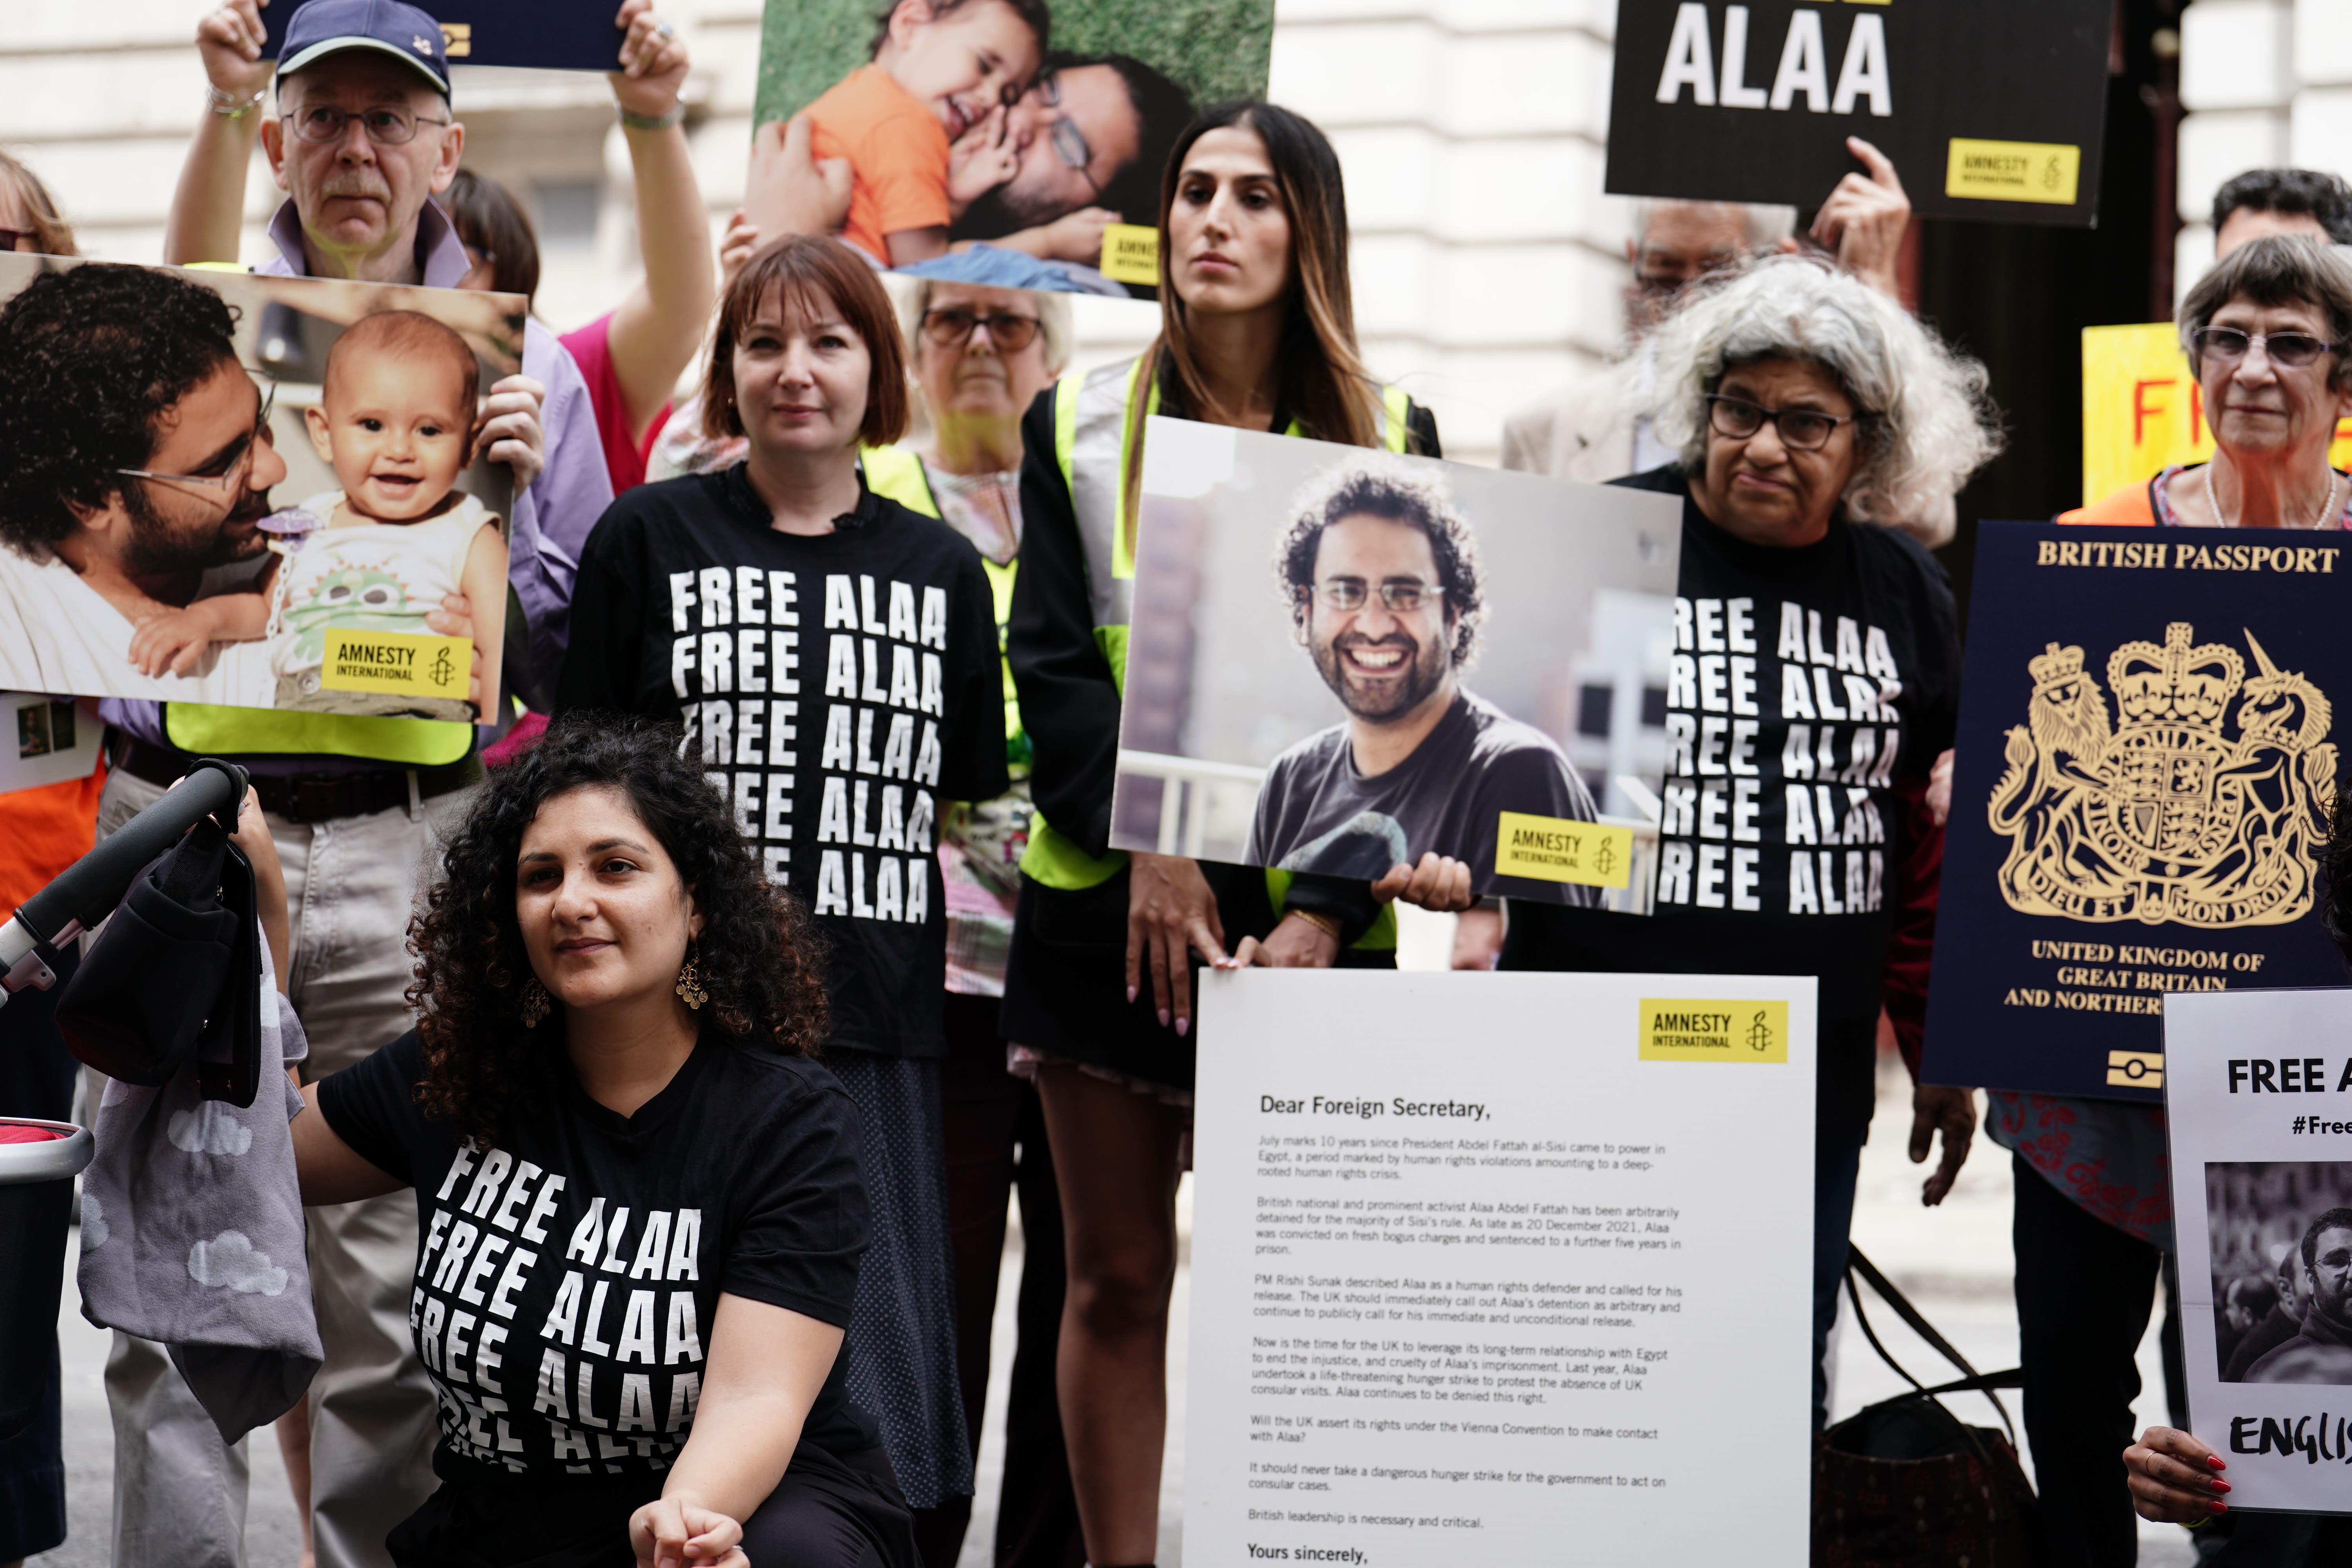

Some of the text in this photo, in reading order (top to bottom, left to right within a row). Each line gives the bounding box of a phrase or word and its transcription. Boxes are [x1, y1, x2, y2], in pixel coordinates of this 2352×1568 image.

[1655, 2, 1892, 117] ALAA
[1115, 238, 1159, 256] AMNE
[2037, 541, 2340, 573] BRITISH PASSPORT
[670, 566, 946, 651] FREE ALAA
[1673, 597, 1898, 679] REE ALAA
[338, 643, 416, 665] AMNESTY
[337, 666, 413, 681] INTERNATIONAL
[671, 630, 943, 717] FREE ALAA
[1667, 654, 1903, 722] REE ALAA
[822, 704, 941, 786] ALAA
[1666, 713, 1898, 789] REE ALAA
[817, 776, 935, 853] ALAA
[1662, 778, 1884, 845] REE ALAA
[1512, 828, 1582, 853] AMNESTY
[1510, 850, 1580, 869] INTERNATIONAL
[814, 850, 927, 924] ALAA
[1657, 841, 1883, 915] REE ALAA
[2030, 871, 2294, 922] DIEU ET MON DROIT
[2032, 939, 2265, 973] UNITED KINGDOM OF
[2057, 965, 2227, 991] GREAT BRITAIN
[2004, 988, 2161, 1016] AND NORTHER
[1653, 1012, 1731, 1035] AMNESTY
[1652, 1034, 1731, 1049] INTERNATIONAL
[2228, 1058, 2325, 1093] FREE
[1260, 1095, 1491, 1122] Dear Foreign Secretary,
[436, 1135, 701, 1281] FREE ALAA
[418, 1208, 703, 1365] FREE ALAA
[1255, 1274, 1682, 1297] PM Rishi Sunak described Alaa as a human rights defender and called for his
[1254, 1290, 1681, 1314] release. The UK should immediately call out Alaa's detention as arbitrary and
[1253, 1307, 1634, 1327] continue to publicly call for his immediate and unconditional release.
[410, 1286, 701, 1432] FREE ALAA
[1253, 1336, 1668, 1362] Now is the time for the UK to leverage its long-term relationship with Egypt
[1252, 1353, 1648, 1376] to end the injustice, and cruelty of Alaa's imprisonment. Last year, Alaa
[1252, 1368, 1642, 1391] undertook a life-threatening hunger strike to protest the absence of UK
[1251, 1385, 1546, 1406] consular visits. Alaa continues to be denied this right.
[1248, 1508, 1483, 1528] British leadership is necessary and critical.
[1247, 1543, 1368, 1566] Yours sincerely,
